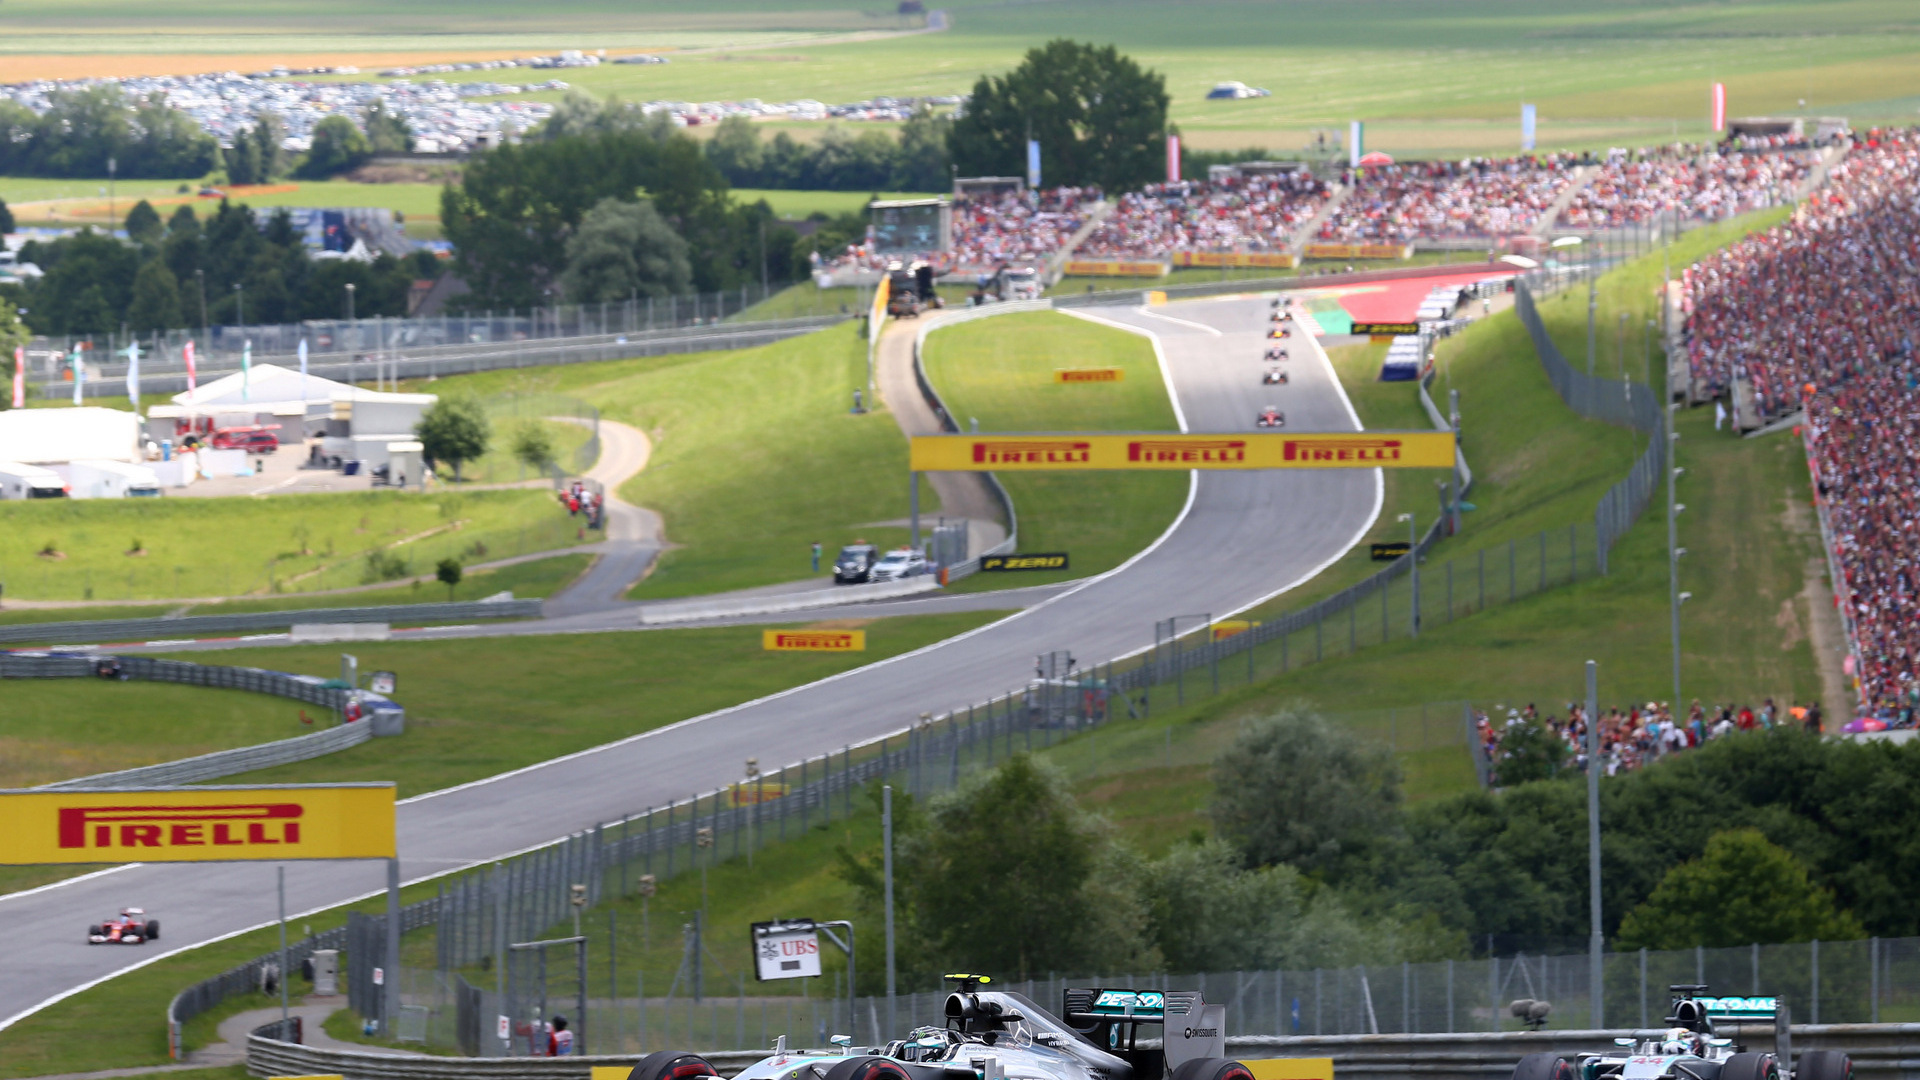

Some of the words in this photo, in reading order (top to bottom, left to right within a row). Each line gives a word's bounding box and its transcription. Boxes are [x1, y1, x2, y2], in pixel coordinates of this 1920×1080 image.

[973, 442, 1090, 463] PIRELLI
[1128, 441, 1246, 462] PIRELLI
[1283, 440, 1402, 461] PIRELLI
[984, 558, 1002, 569] P
[1004, 556, 1065, 569] ZERO
[776, 634, 852, 648] PIRELLI
[59, 804, 304, 848] PIRELLI
[781, 938, 818, 956] UBS
[1632, 1057, 1664, 1065] 44
